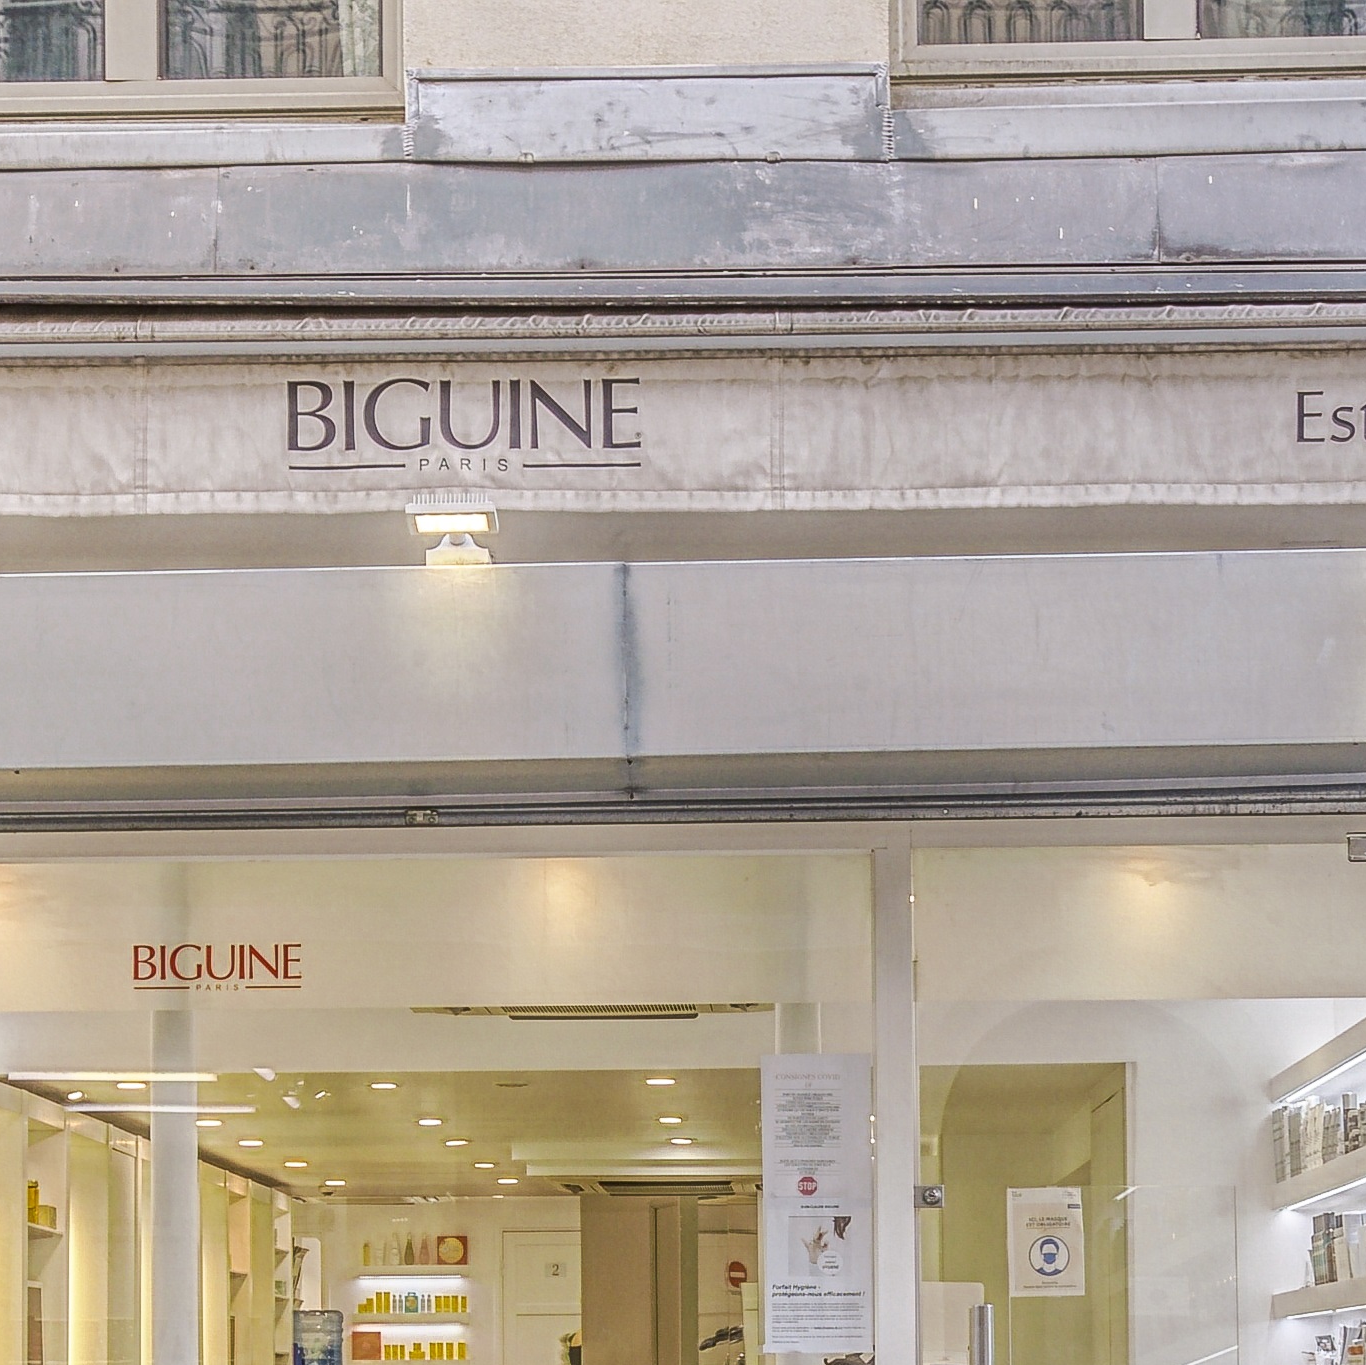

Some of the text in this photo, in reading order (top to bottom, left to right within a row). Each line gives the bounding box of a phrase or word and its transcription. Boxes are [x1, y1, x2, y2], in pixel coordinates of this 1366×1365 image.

[287, 377, 641, 451] BIGUINE
[419, 458, 509, 472] PARIS
[133, 943, 302, 980] BIGUINE
[798, 1181, 817, 1192] STOP
[552, 1264, 559, 1276] 2
